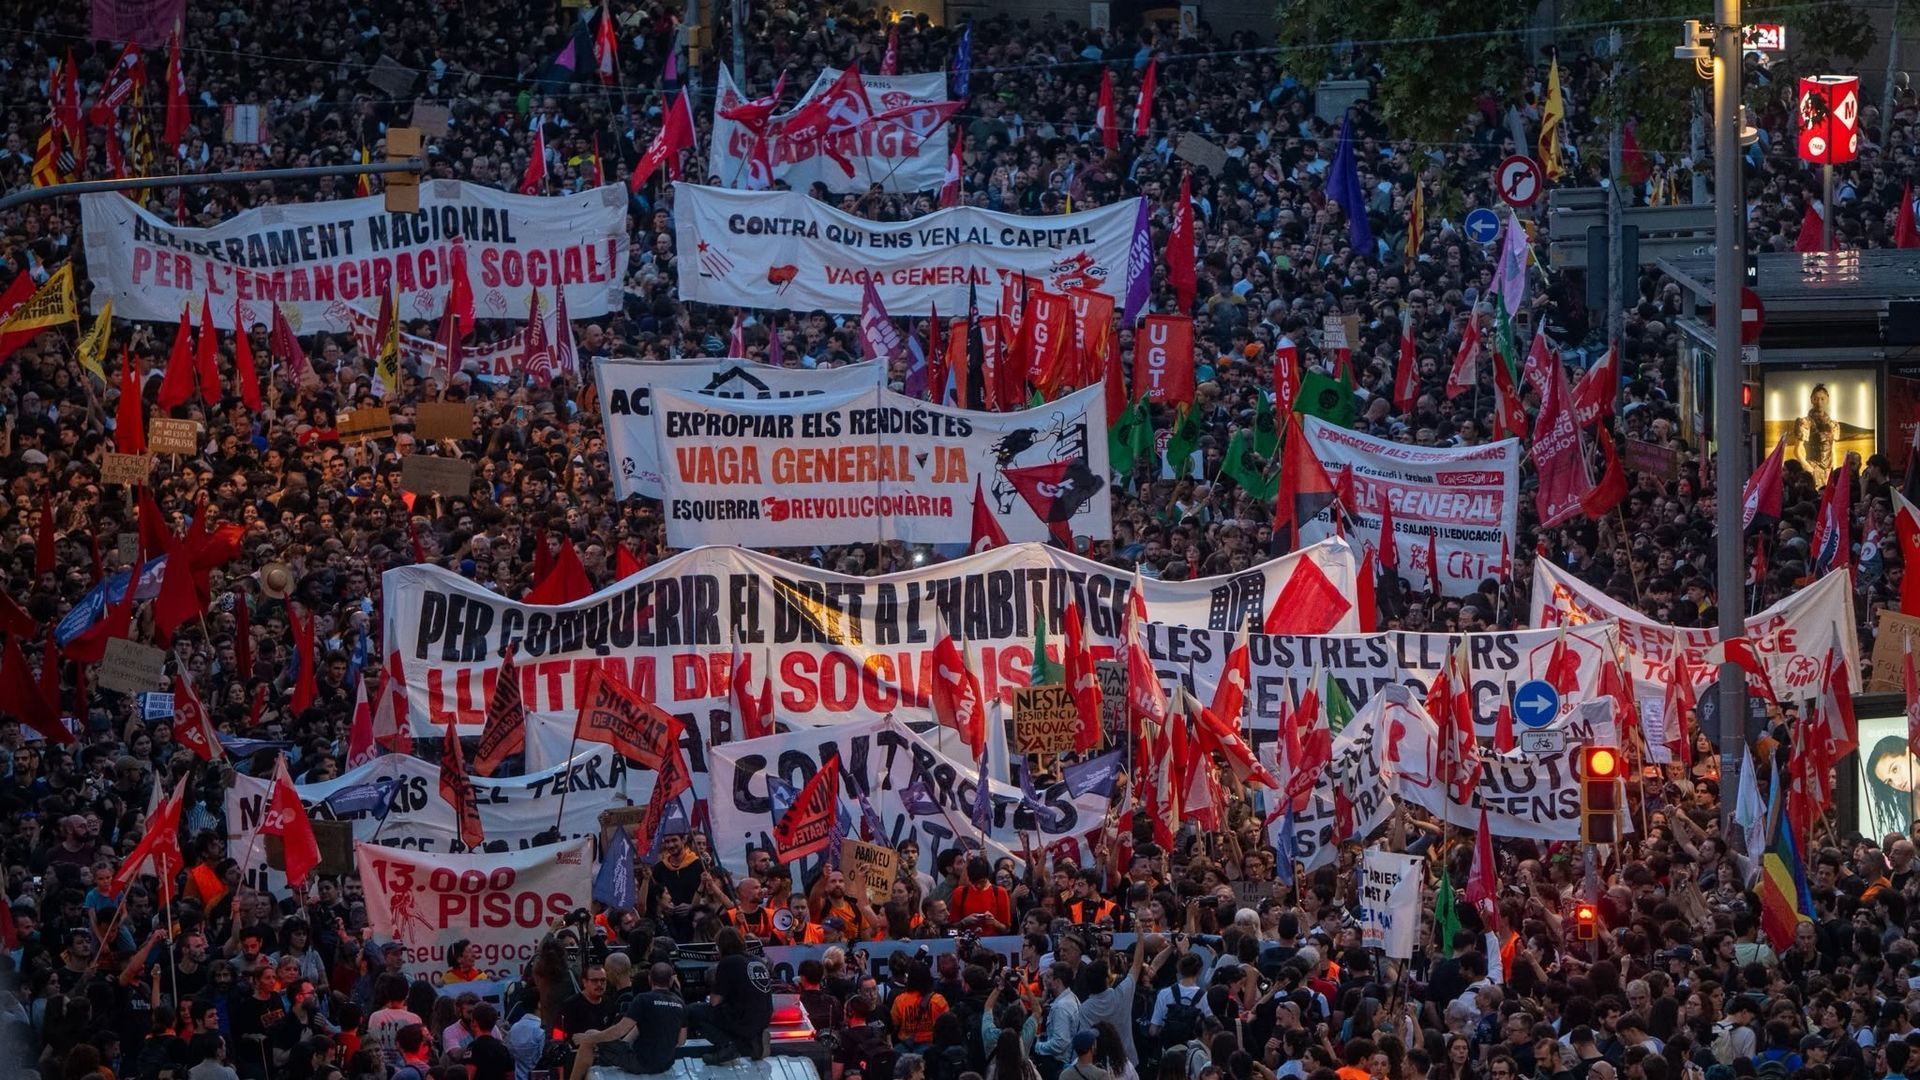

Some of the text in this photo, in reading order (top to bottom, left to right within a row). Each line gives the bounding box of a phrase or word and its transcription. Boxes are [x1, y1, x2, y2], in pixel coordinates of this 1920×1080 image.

[1844, 101, 1855, 120] M
[368, 205, 517, 251] NACIONAL
[728, 213, 1096, 249] CONTRA QUI ENS VEN AL CAPITAL
[132, 246, 193, 290] PER
[481, 237, 618, 288] SOCIAL!
[825, 264, 992, 287] VAGA GENERAL
[1034, 299, 1050, 367] UGT
[1147, 324, 1168, 389] UGT
[666, 406, 973, 438] EXPROPIAR ELS RENDISTES
[676, 445, 969, 485] VAGA GENERAL JA
[672, 489, 953, 523] ESQUERRA REVOLUCIONÀRIA
[1387, 474, 1499, 522] GENERAL
[1447, 551, 1489, 580] CRT
[416, 590, 495, 663] PER
[497, 575, 721, 660] CONQUERIR
[729, 574, 765, 644] EL
[771, 575, 866, 646] DRET
[875, 582, 899, 645] A
[1017, 736, 1051, 754] YA!
[526, 752, 628, 800] TERRA
[372, 859, 517, 894] 13.000
[438, 891, 574, 929] PISOS
